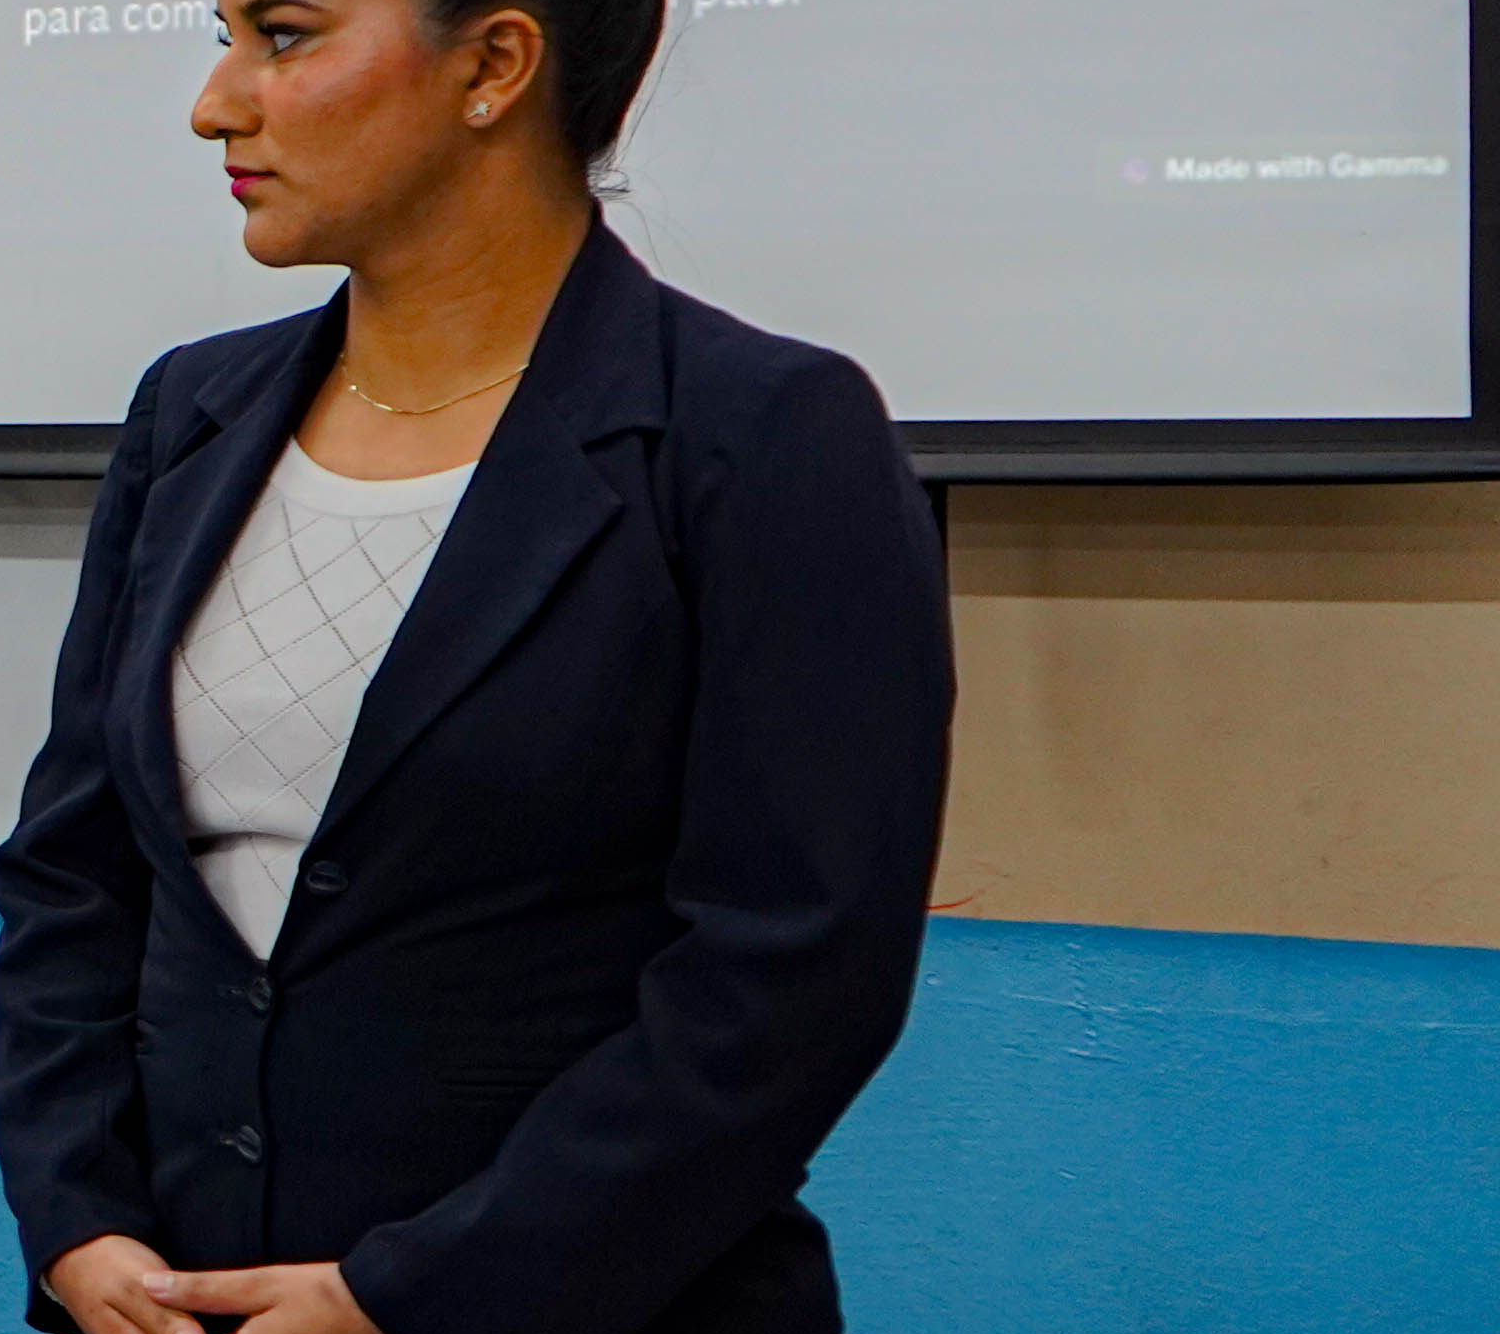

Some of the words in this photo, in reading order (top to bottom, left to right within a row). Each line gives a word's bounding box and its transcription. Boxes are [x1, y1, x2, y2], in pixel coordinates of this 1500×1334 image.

[24, 4, 110, 46] para
[1165, 157, 1250, 182] Made
[1257, 155, 1326, 179] with
[1329, 152, 1452, 178] Gamma
